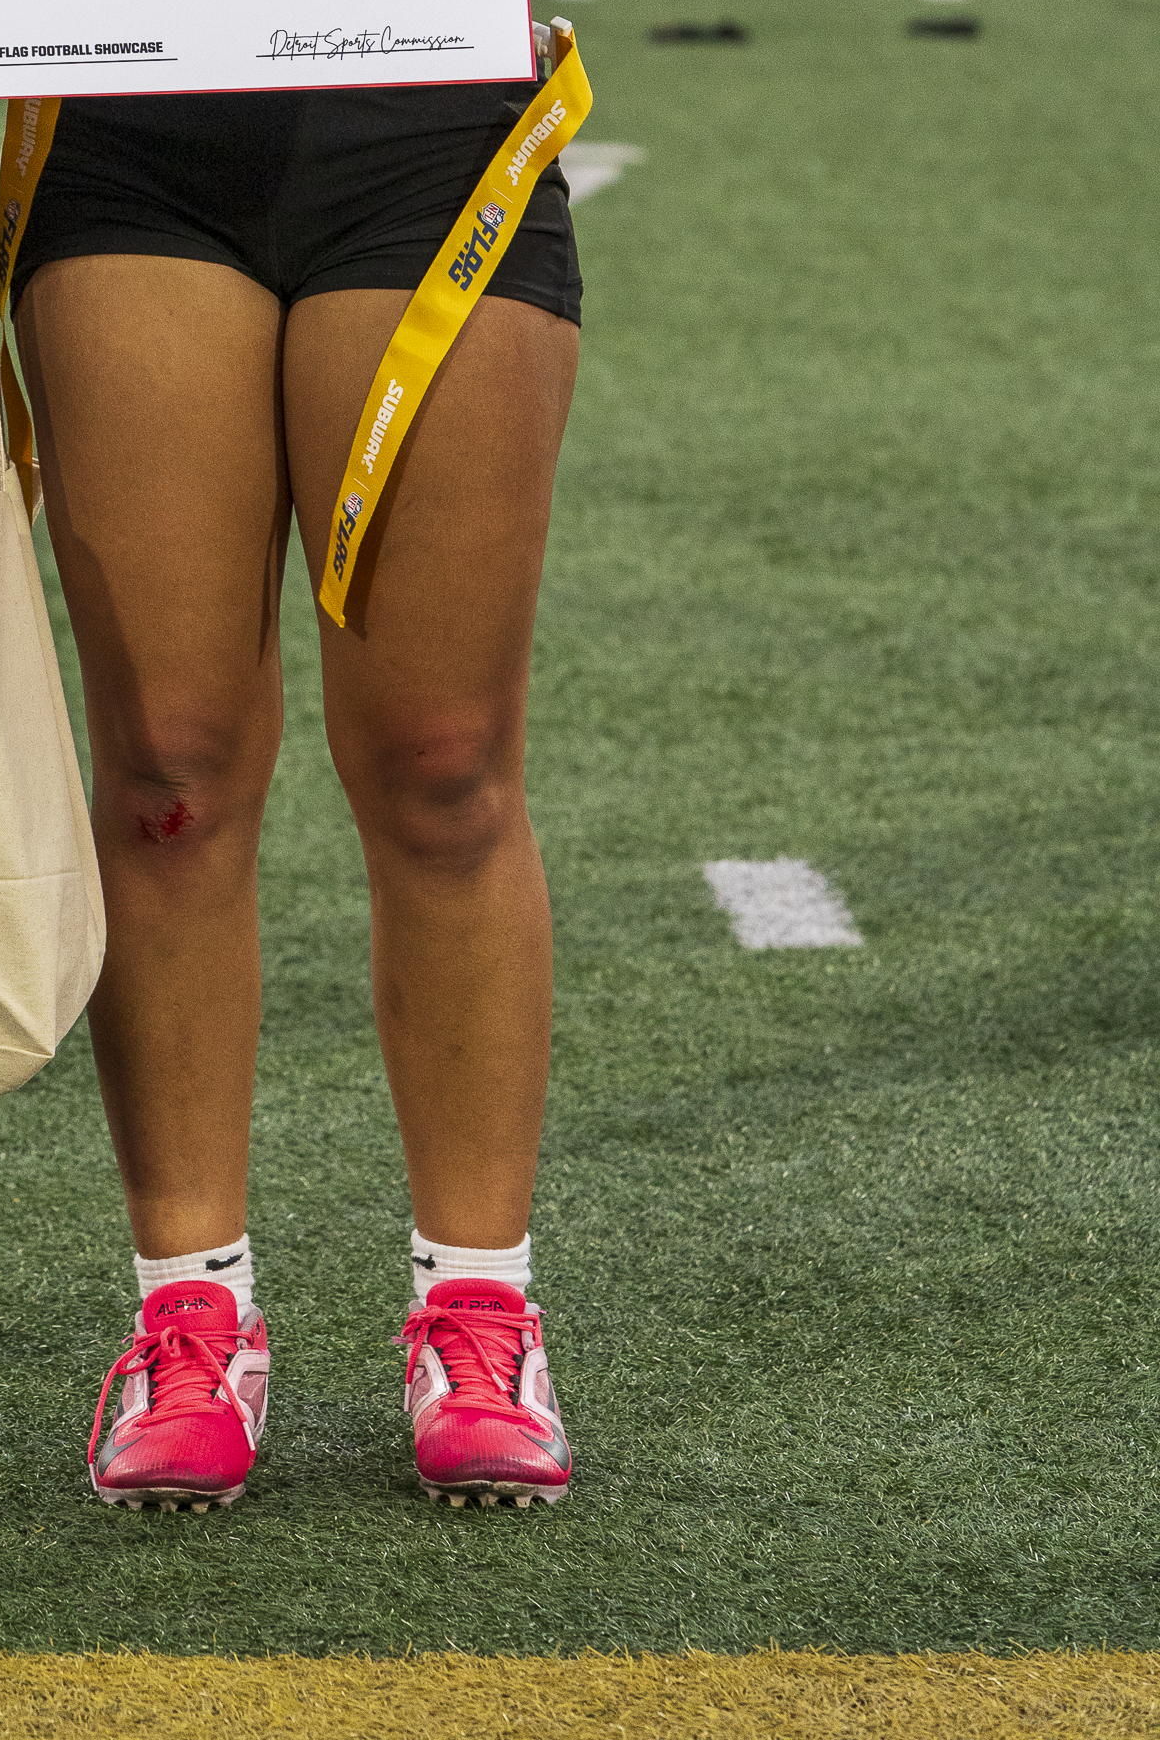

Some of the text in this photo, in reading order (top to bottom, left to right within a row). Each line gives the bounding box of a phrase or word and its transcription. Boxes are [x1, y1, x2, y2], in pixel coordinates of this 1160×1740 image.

[31, 44, 92, 57] FOOTBALL
[94, 41, 164, 55] SHOWCASE
[270, 26, 465, 60] Detroit Sports Commission
[15, 98, 42, 177] UBWAY
[507, 99, 567, 186] SUBWAY
[361, 378, 404, 475] SUBWAY
[155, 1297, 214, 1318] ALPHA
